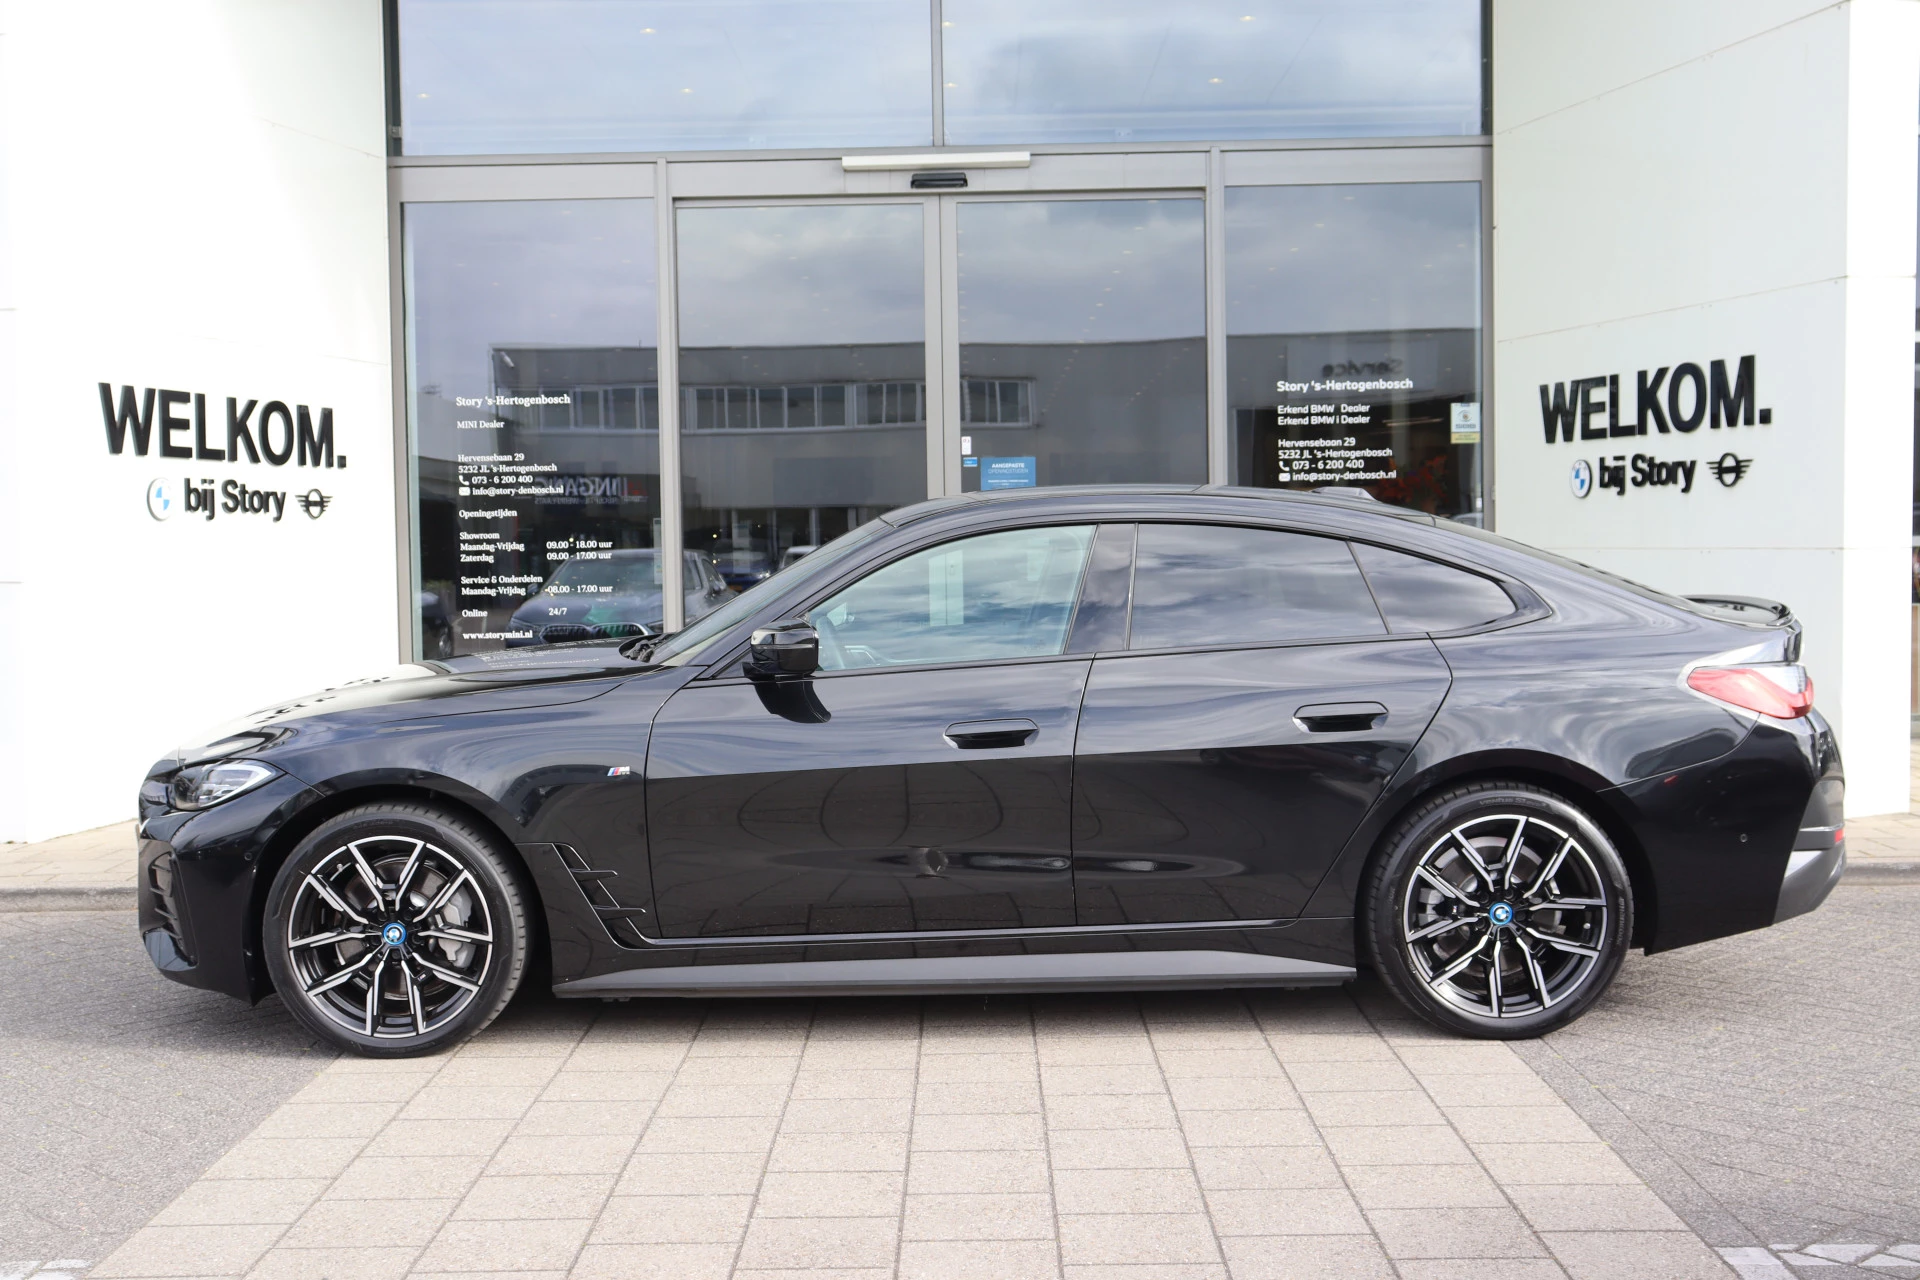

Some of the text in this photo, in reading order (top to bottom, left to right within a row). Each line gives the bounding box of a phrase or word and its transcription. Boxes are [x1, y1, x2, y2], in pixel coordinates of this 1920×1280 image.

[1277, 380, 1309, 393] Story
[456, 396, 482, 408] Story
[1539, 354, 1773, 444] WELKOM.
[1278, 403, 1370, 414] Erkend BMW Dealer
[98, 382, 347, 468] WELKOM.
[457, 420, 504, 429] MINI Dealer
[1278, 416, 1309, 425] Erkend
[1311, 415, 1335, 424] BMW
[1341, 414, 1370, 424] Dealer
[1278, 437, 1356, 448] Hervensebaan 29
[458, 453, 525, 462] Hervensebaan 29
[1278, 450, 1300, 459] 5232
[1302, 450, 1312, 459] JL
[458, 465, 478, 474] 5232
[479, 465, 489, 473] JL
[1292, 461, 1309, 470] 073
[1317, 460, 1324, 470] 6
[1325, 460, 1344, 469] 200
[1346, 460, 1364, 469] 400
[472, 476, 487, 484] 073
[494, 476, 499, 484] 6
[501, 476, 516, 484] 200
[518, 475, 533, 483] 400
[1292, 470, 1396, 482] info@story-denbosch.nl
[1599, 453, 1696, 496] bij Story
[472, 486, 564, 497] info@story-denbosch.nl
[184, 478, 286, 522] bij Story
[459, 509, 517, 519] Openingstijden
[460, 532, 500, 540] Showroom
[460, 542, 524, 552] Maandag-Vrijdag
[546, 541, 569, 549] 09.00
[576, 540, 597, 548] 18.00
[460, 554, 494, 563] Zaterdag
[547, 552, 569, 560] 09.00
[576, 552, 597, 560] 17.00
[461, 575, 543, 584] Service & Onderdelen
[461, 587, 526, 596] Maandag-Vrijdag
[547, 585, 570, 593] 08.00
[576, 585, 598, 593] 17.00
[599, 585, 613, 593] uur
[462, 608, 567, 618] Online 24/7
[463, 630, 533, 640] www.storymini.nl
